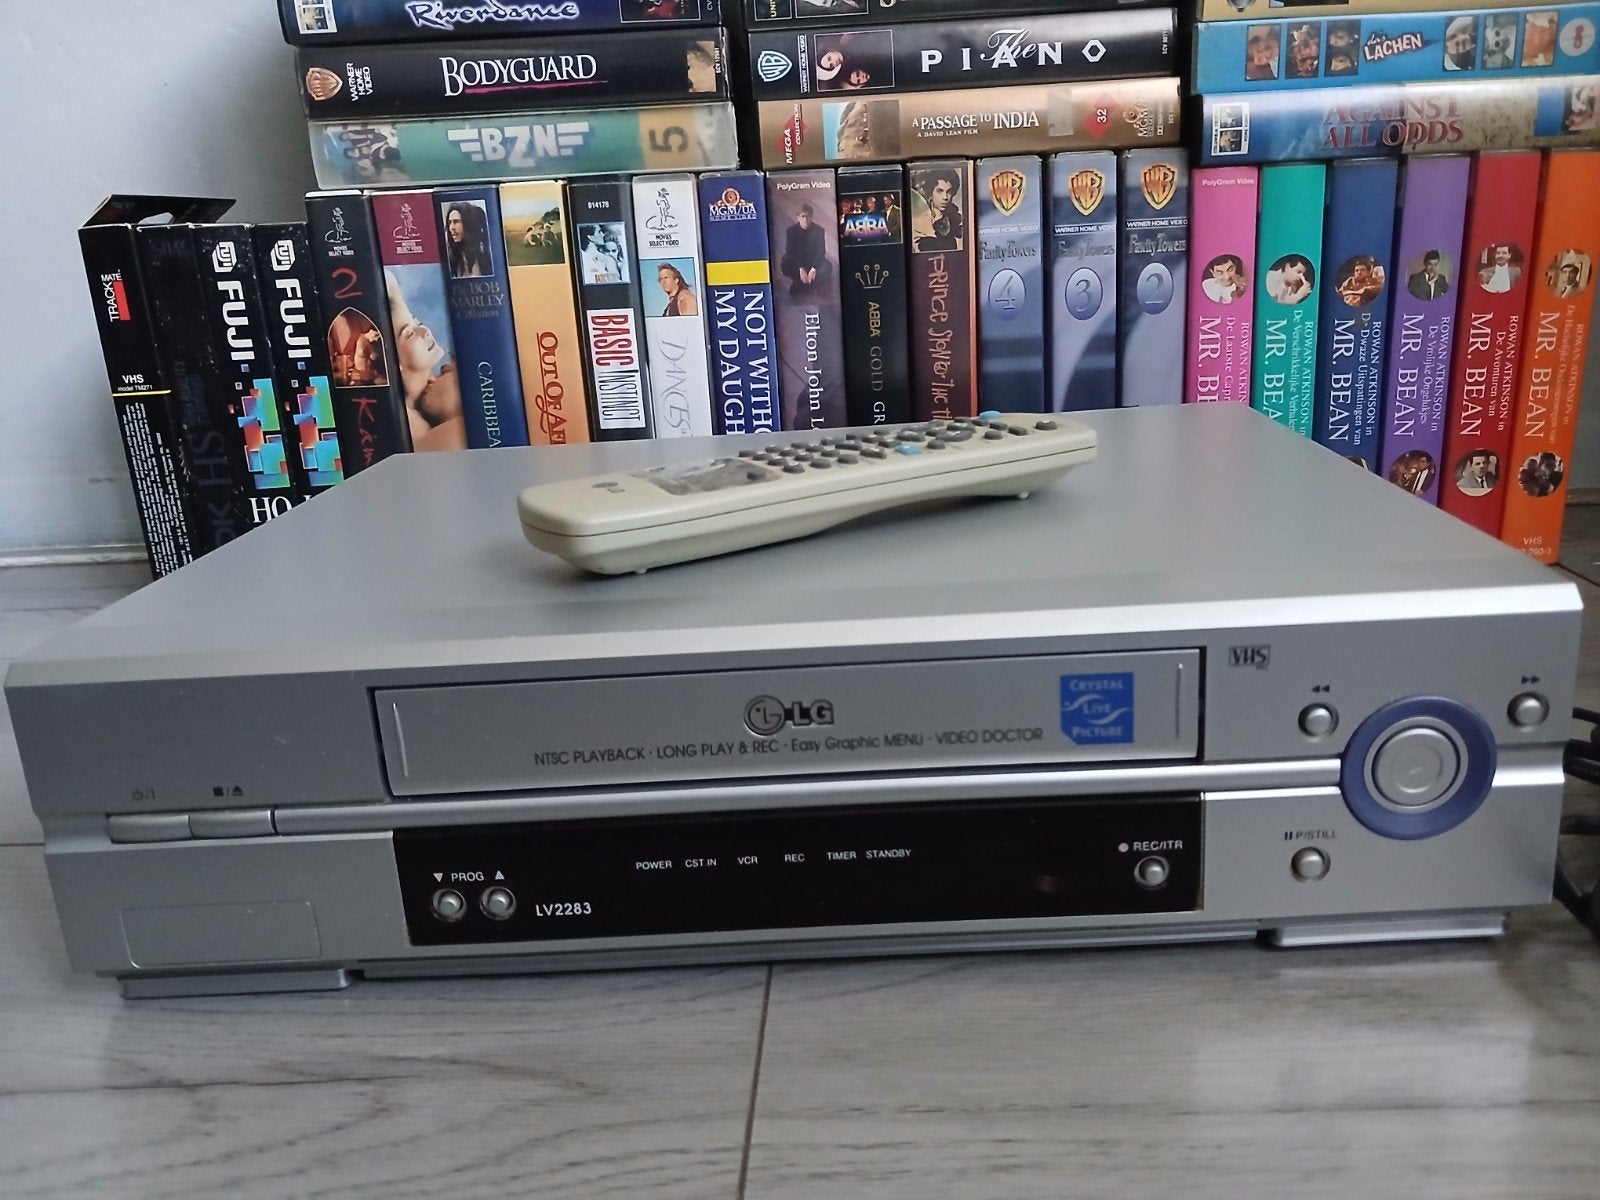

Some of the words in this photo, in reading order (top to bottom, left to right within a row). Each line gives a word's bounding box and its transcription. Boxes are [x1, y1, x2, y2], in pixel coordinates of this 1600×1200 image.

[401, 0, 580, 30] Riverdance
[1364, 34, 1423, 60] LACHEN
[346, 63, 359, 101] WARNER
[355, 68, 366, 95] HOME
[362, 66, 373, 95] VIDEO
[439, 54, 597, 96] BODYGUARD
[793, 104, 801, 145] COLLECTION
[912, 118, 919, 127] A
[921, 114, 978, 130] PASSAGE
[980, 113, 992, 122] TO
[993, 110, 1040, 129] INDIA
[1096, 109, 1107, 123] 32
[1324, 96, 1461, 125] AGAINST
[481, 122, 563, 168] BZN
[648, 126, 689, 152] 5
[784, 129, 793, 165] MEGA
[1323, 124, 1377, 148] ALL
[1382, 119, 1463, 146] ODDS
[776, 182, 811, 191] PolyGram
[811, 180, 831, 188] Video
[1202, 178, 1236, 187] PolyGram
[1237, 177, 1255, 185] Video
[708, 203, 757, 217] MGM/UA
[845, 216, 889, 235] ABBA
[101, 272, 122, 282] MATE
[332, 267, 362, 299] 2
[995, 275, 1015, 310] 4
[1145, 272, 1164, 304] 2
[103, 281, 120, 322] TRACK
[714, 289, 739, 335] MY
[1075, 278, 1092, 312] 3
[1566, 305, 1575, 317] De
[217, 281, 255, 360] FUJI
[275, 279, 312, 358] FUJI
[744, 291, 768, 358] NOT
[868, 302, 881, 337] ABBA
[1226, 317, 1235, 331] De
[1293, 310, 1303, 322] De
[1428, 326, 1438, 338] De
[591, 314, 634, 366] BASIC
[804, 312, 821, 362] Elton
[1198, 316, 1221, 368] MR.
[1239, 322, 1250, 365] ROWAN
[1264, 319, 1288, 365] MR.
[1303, 321, 1314, 364] ROWAN
[1332, 318, 1356, 365] MR.
[1359, 329, 1369, 362] Dwaze
[1370, 321, 1382, 364] ROWAN
[1399, 313, 1424, 360] MR.
[1438, 316, 1450, 359] ROWAN
[1467, 312, 1493, 359] MR.
[1495, 332, 1506, 345] De
[1505, 315, 1519, 358] ROWAN
[1534, 312, 1560, 359] MR.
[1572, 324, 1584, 361] ROWAN
[539, 331, 559, 379] OUT
[869, 346, 883, 391] GOLD
[1225, 335, 1235, 372] Laatste
[1424, 340, 1437, 374] Vrolijke
[122, 374, 144, 384] VHS
[657, 336, 693, 430] DANCES
[718, 340, 745, 435] DAUGH
[805, 366, 825, 411] John
[1238, 368, 1248, 402] ATKIN
[1490, 348, 1503, 397] Avonturen
[1499, 361, 1513, 419] ATKINSON
[1565, 365, 1578, 413] ATKINSON
[478, 361, 502, 447] CARIBBEA
[545, 381, 564, 411] OF
[598, 369, 640, 421] INSTINCT
[1263, 373, 1285, 420] BEA
[1300, 367, 1312, 424] ATKINSON
[1328, 372, 1353, 441] BEAN
[1354, 364, 1369, 426] Uitspattingen
[1366, 367, 1378, 424] ATKINSON
[1393, 367, 1419, 437] BEAN
[1419, 376, 1433, 424] Ongelukjes
[1432, 362, 1445, 420] ATKINSON
[1460, 367, 1487, 436] BEAN
[1488, 400, 1496, 416] van
[1524, 367, 1552, 437] BEAN
[872, 401, 886, 424] GR
[1431, 422, 1439, 431] in
[1497, 421, 1506, 431] in
[1353, 428, 1362, 446] van
[1365, 426, 1374, 435] in
[1231, 646, 1268, 665] VHS
[1070, 680, 1124, 691] CRYSTAL
[792, 698, 835, 727] LG
[534, 751, 569, 766] NTSC
[573, 747, 645, 764] PLAYBACK
[657, 744, 697, 759] LONG
[702, 741, 734, 757] PLAY
[738, 740, 750, 754] &
[753, 740, 779, 754] REC
[791, 738, 820, 754] Easy
[825, 734, 879, 752] Graphic
[884, 733, 924, 747] MENU
[935, 731, 978, 745] VIDEO
[982, 728, 1044, 744] DOCTOR
[1072, 726, 1124, 738] PICTURE
[685, 859, 704, 868] CST
[707, 858, 717, 866] IN
[737, 856, 758, 865] VCR
[784, 853, 805, 863] REC
[827, 851, 857, 861] TIMER
[866, 849, 912, 859] STANDBY
[1133, 840, 1183, 851] REC/ITR
[451, 872, 485, 882] PROG
[635, 860, 672, 870] POWER
[535, 902, 592, 917] LV2283
